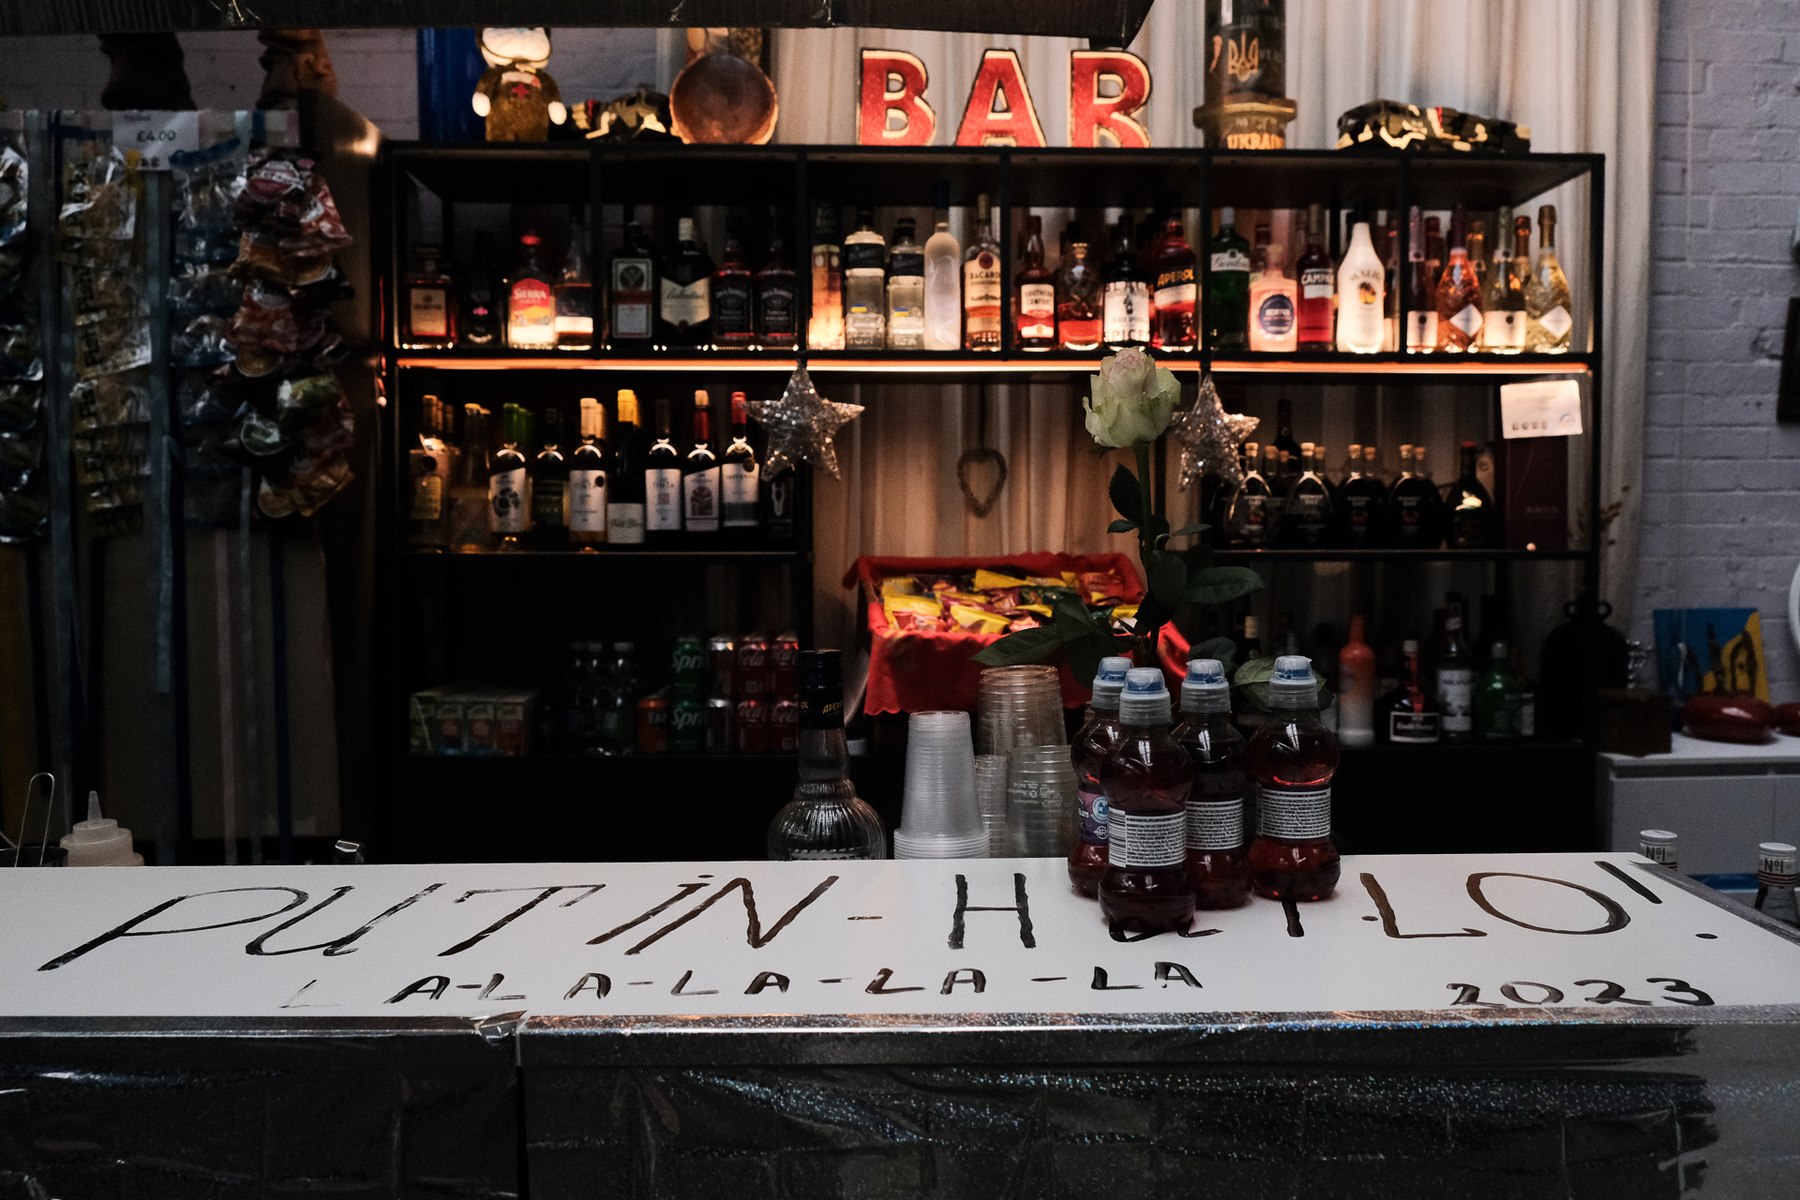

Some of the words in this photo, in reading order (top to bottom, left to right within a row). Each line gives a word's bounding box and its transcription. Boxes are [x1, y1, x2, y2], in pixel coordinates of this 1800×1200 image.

[856, 48, 1152, 147] BAR
[137, 130, 176, 142] £4.00
[1157, 268, 1194, 287] APEROL
[1446, 977, 1717, 1008] 2023
